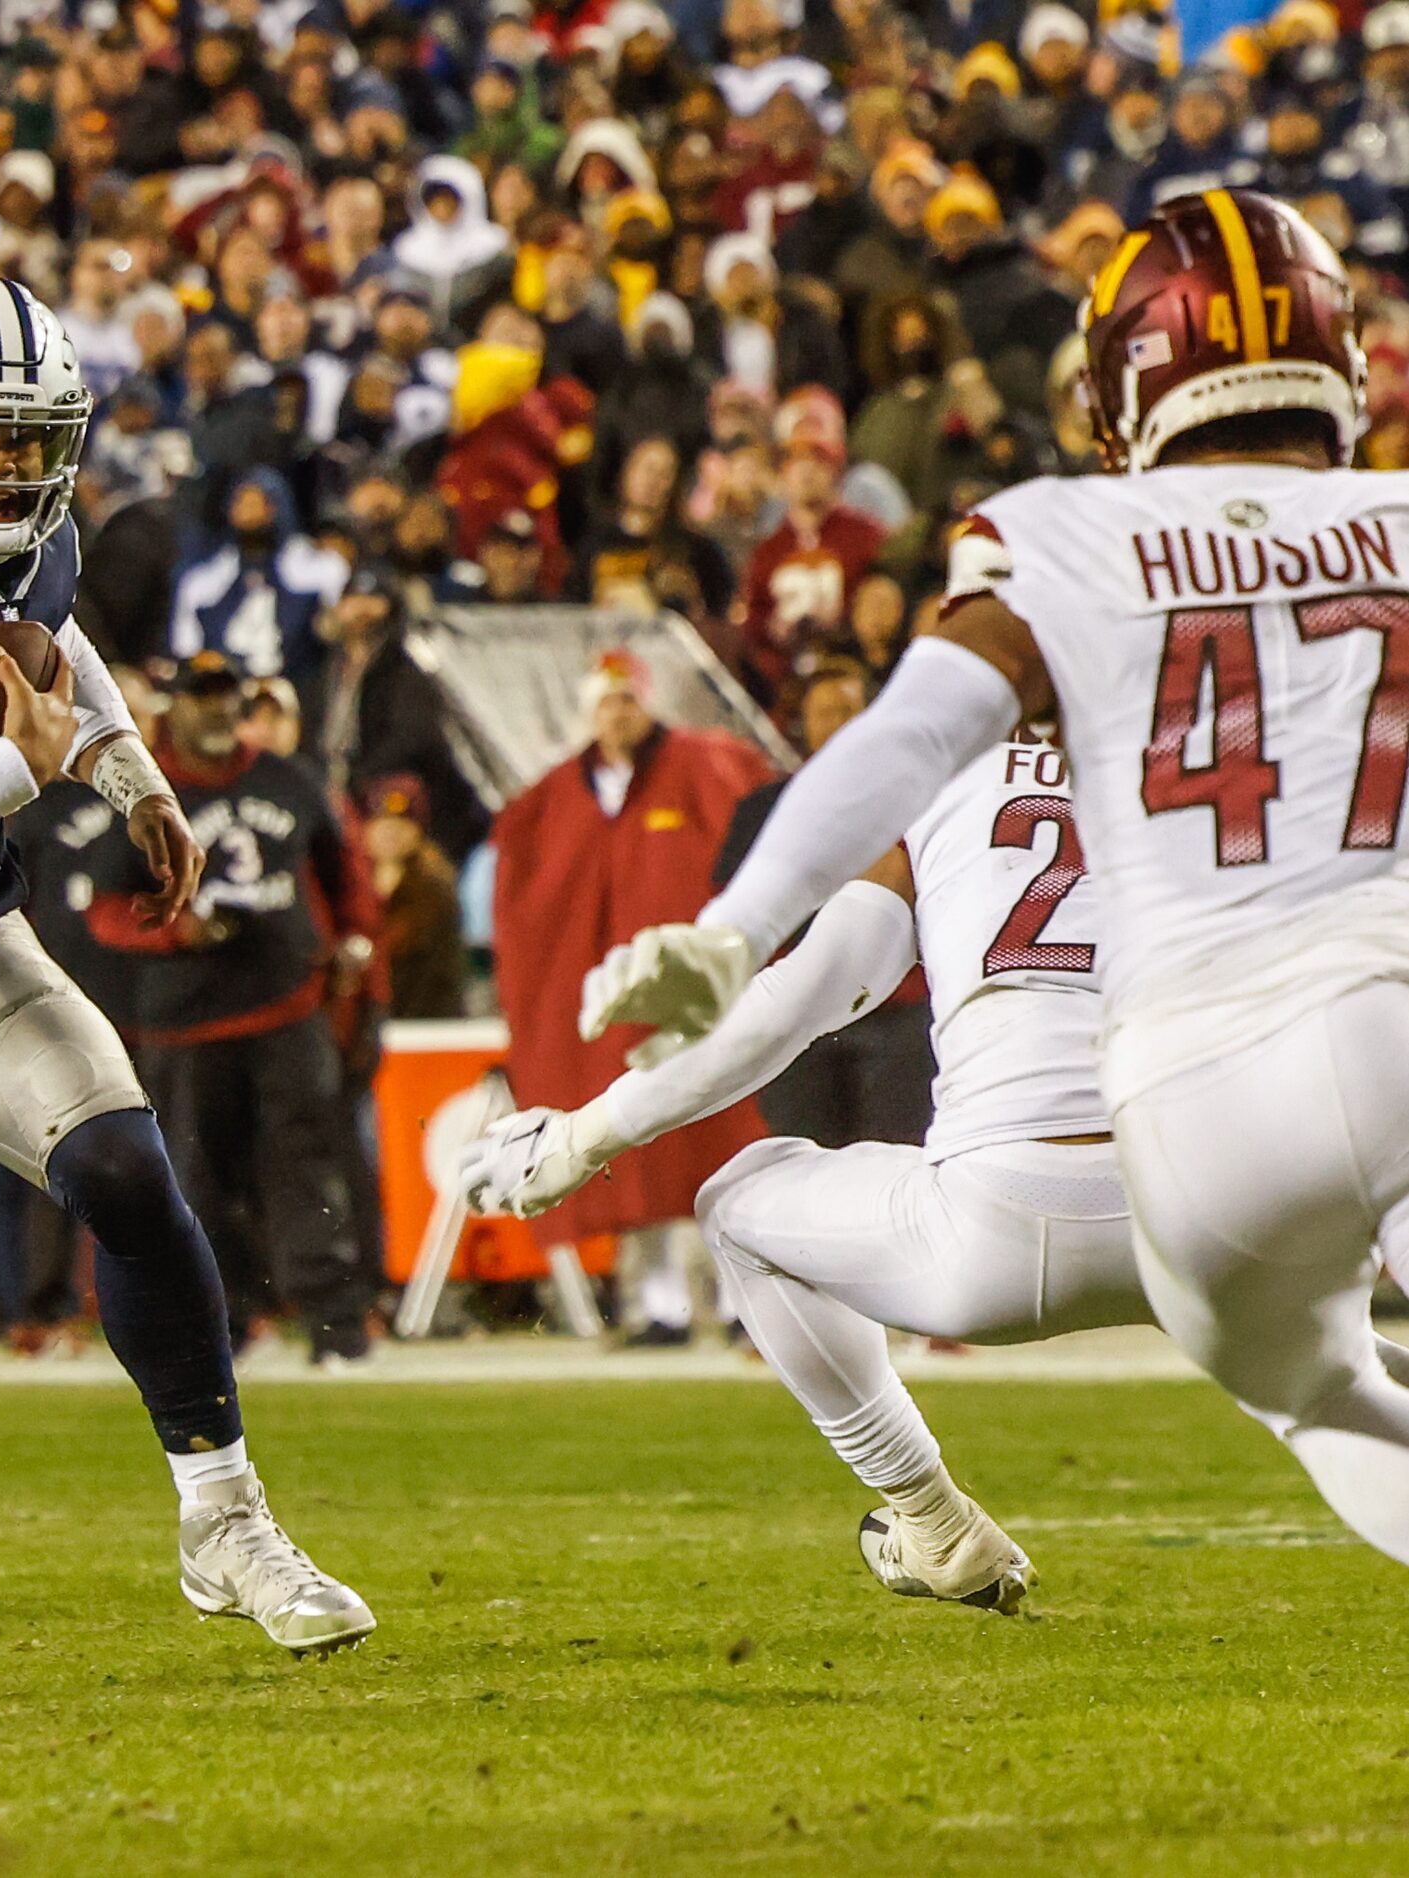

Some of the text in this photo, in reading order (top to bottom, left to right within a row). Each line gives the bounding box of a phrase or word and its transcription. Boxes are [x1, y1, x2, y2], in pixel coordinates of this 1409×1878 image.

[1133, 519, 1398, 600] HUDSON
[223, 587, 283, 677] 4
[1140, 588, 1409, 867] 47
